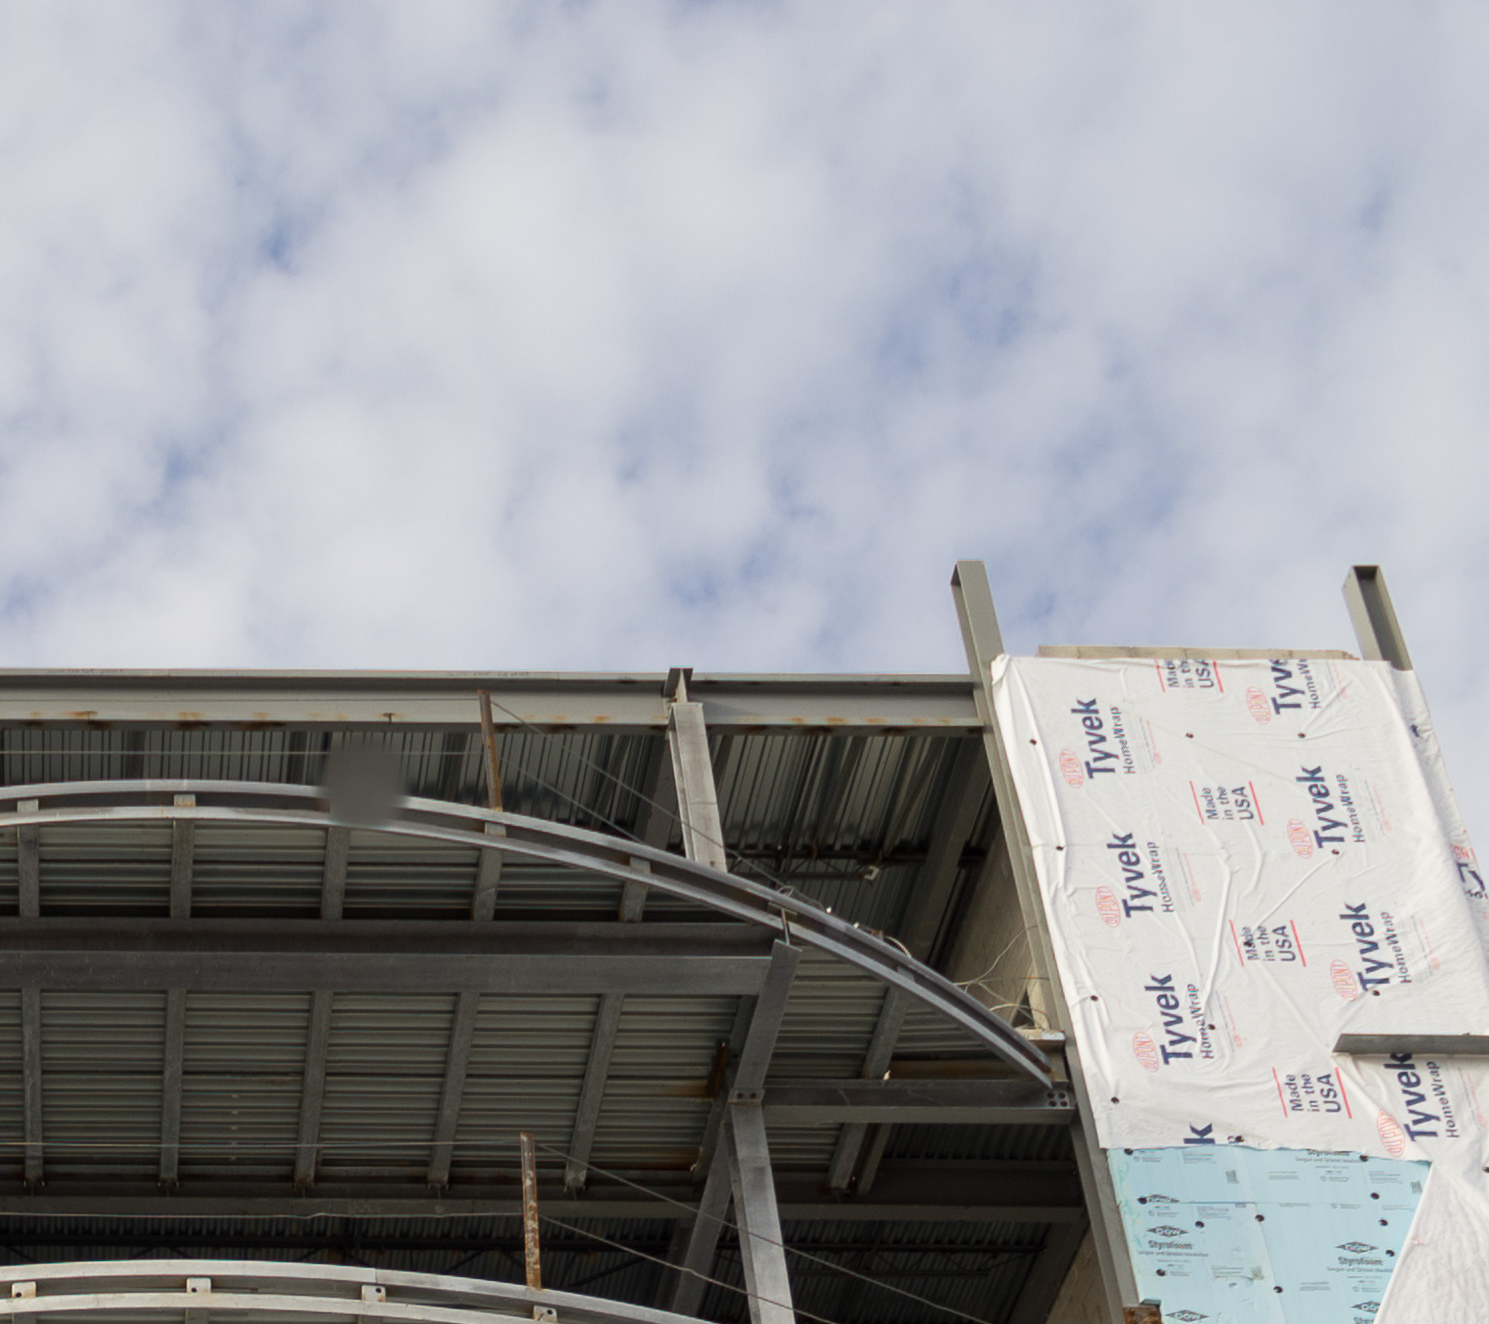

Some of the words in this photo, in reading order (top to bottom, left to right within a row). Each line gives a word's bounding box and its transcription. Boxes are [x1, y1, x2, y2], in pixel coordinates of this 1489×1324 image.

[1183, 678, 1194, 688] in
[1070, 697, 1119, 779] Tyvek
[1110, 706, 1136, 774] HomeWrap
[1221, 809, 1234, 821] in
[1231, 786, 1254, 820] USA
[1296, 765, 1348, 849] Tyvek
[1336, 774, 1365, 843] HomeWrap
[1106, 832, 1158, 918] Tyvek
[1147, 841, 1175, 914] HomeWrap
[1263, 949, 1276, 962] in
[1272, 925, 1297, 962] USA
[1339, 902, 1394, 992] Tyvek
[1380, 911, 1412, 984] HomeWrap
[1144, 973, 1197, 1065] Tyvek
[1187, 983, 1214, 1060] HomeWrap
[1307, 1102, 1320, 1112] in
[1317, 1073, 1342, 1113] USA
[1426, 1061, 1460, 1138] HomeWrap
